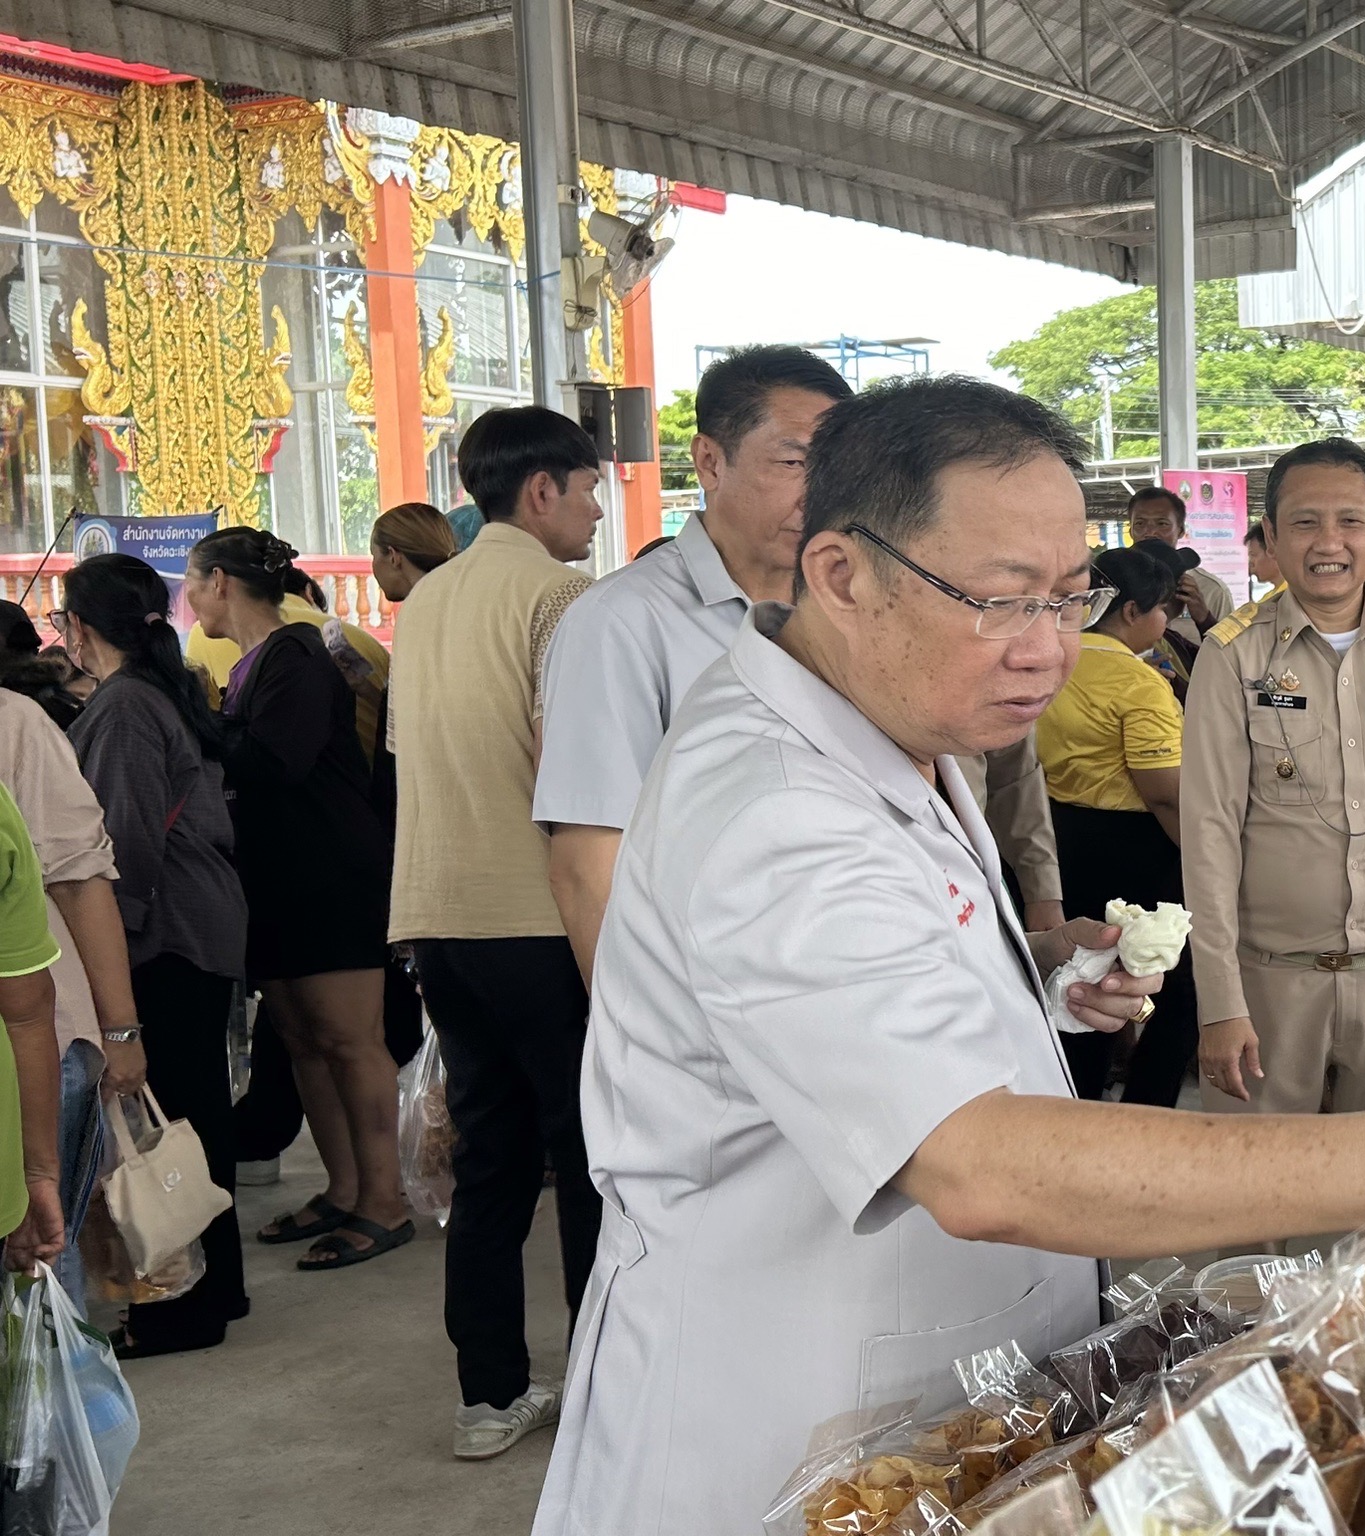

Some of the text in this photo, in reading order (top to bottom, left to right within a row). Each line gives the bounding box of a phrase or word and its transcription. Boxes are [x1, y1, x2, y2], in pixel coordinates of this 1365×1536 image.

[122, 524, 207, 541] สำนักงานจัดหางาน
